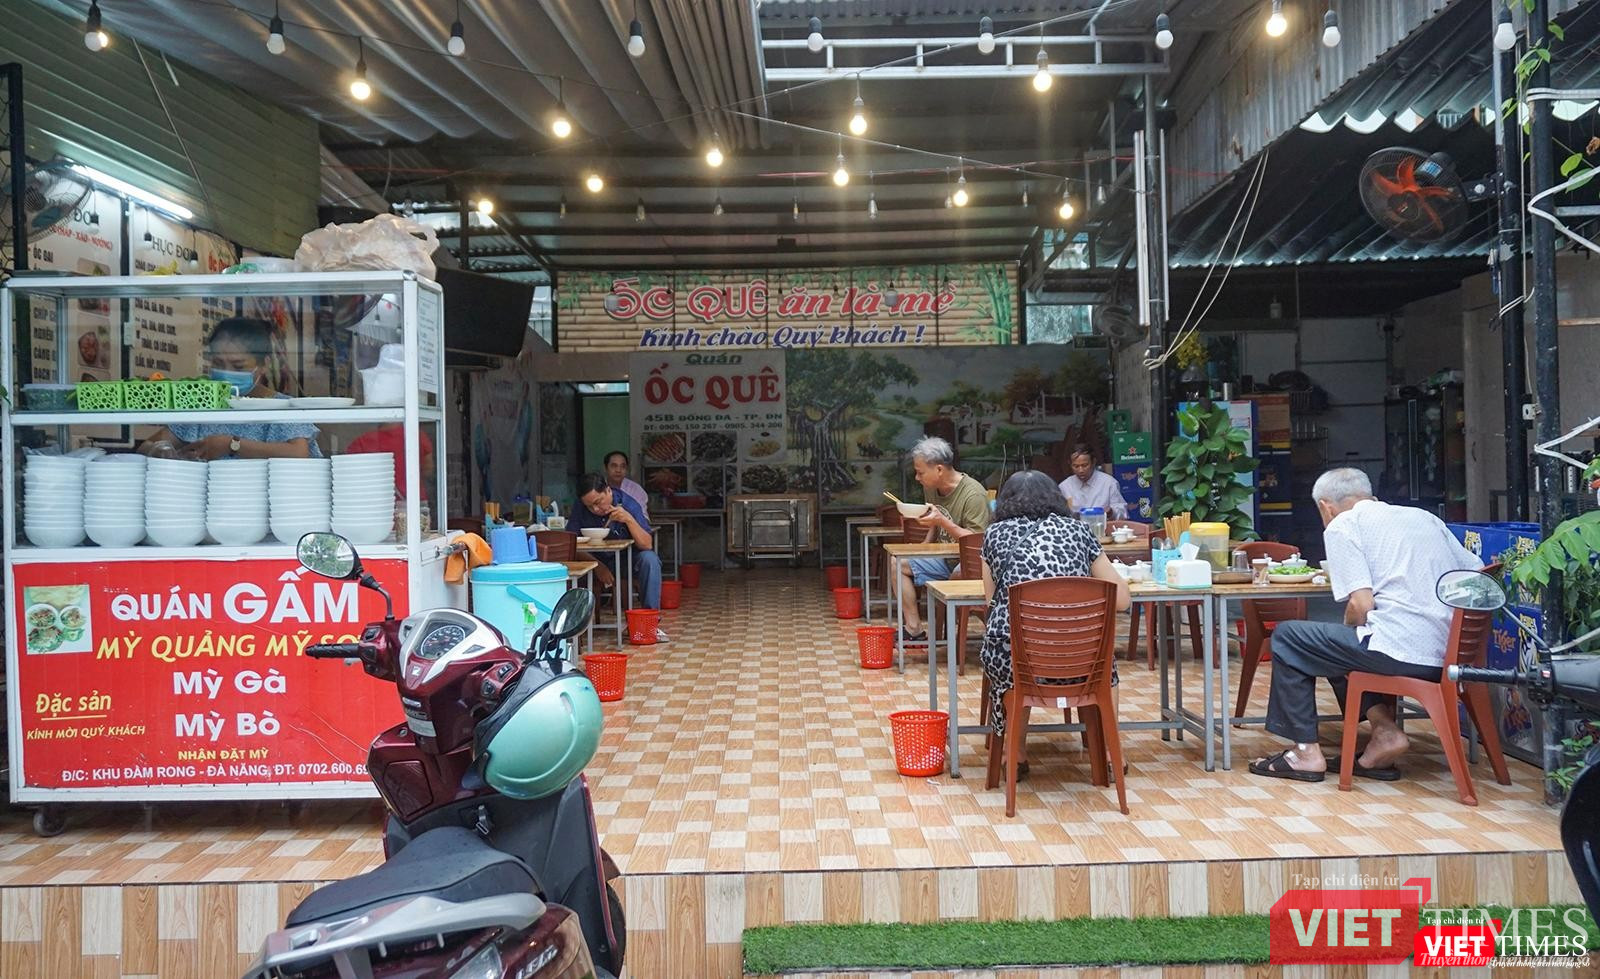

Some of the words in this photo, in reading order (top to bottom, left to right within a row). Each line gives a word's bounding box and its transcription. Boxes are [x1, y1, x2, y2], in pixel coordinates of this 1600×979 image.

[687, 279, 769, 324] QUÊ
[776, 286, 833, 317] ăn
[840, 283, 883, 317] là
[640, 327, 700, 347] Kính
[706, 326, 767, 346] chào
[773, 324, 824, 349] Quý
[829, 324, 908, 345] khách
[684, 352, 743, 366] Quán
[644, 362, 695, 405] ỐC
[705, 365, 781, 410] QUÊ
[644, 413, 675, 422] 45B
[111, 584, 212, 621] QUÁN
[223, 566, 359, 624] GẤM
[96, 631, 143, 659] MỲ
[151, 629, 256, 663] QUẢNG
[264, 629, 312, 656] MỸ
[1493, 627, 1516, 654] Tiger
[172, 668, 224, 699] Mỳ
[233, 668, 288, 694] Gà
[36, 692, 73, 718] Đặc
[78, 689, 112, 711] sản
[26, 727, 53, 740] KÍNH
[56, 727, 79, 739] MỜI
[80, 724, 106, 737] QUÝ
[107, 723, 146, 737] KHÁCH
[174, 711, 226, 742] Mỳ
[236, 710, 281, 737] Bò
[177, 747, 217, 762] NHẬN
[219, 747, 247, 762] ĐẶT
[249, 747, 270, 759] MỲ
[61, 769, 90, 782] Đ/C:
[92, 768, 121, 780] KHU
[156, 765, 196, 778] RONG
[206, 762, 227, 777] ĐÀ
[274, 764, 295, 775] ĐT:
